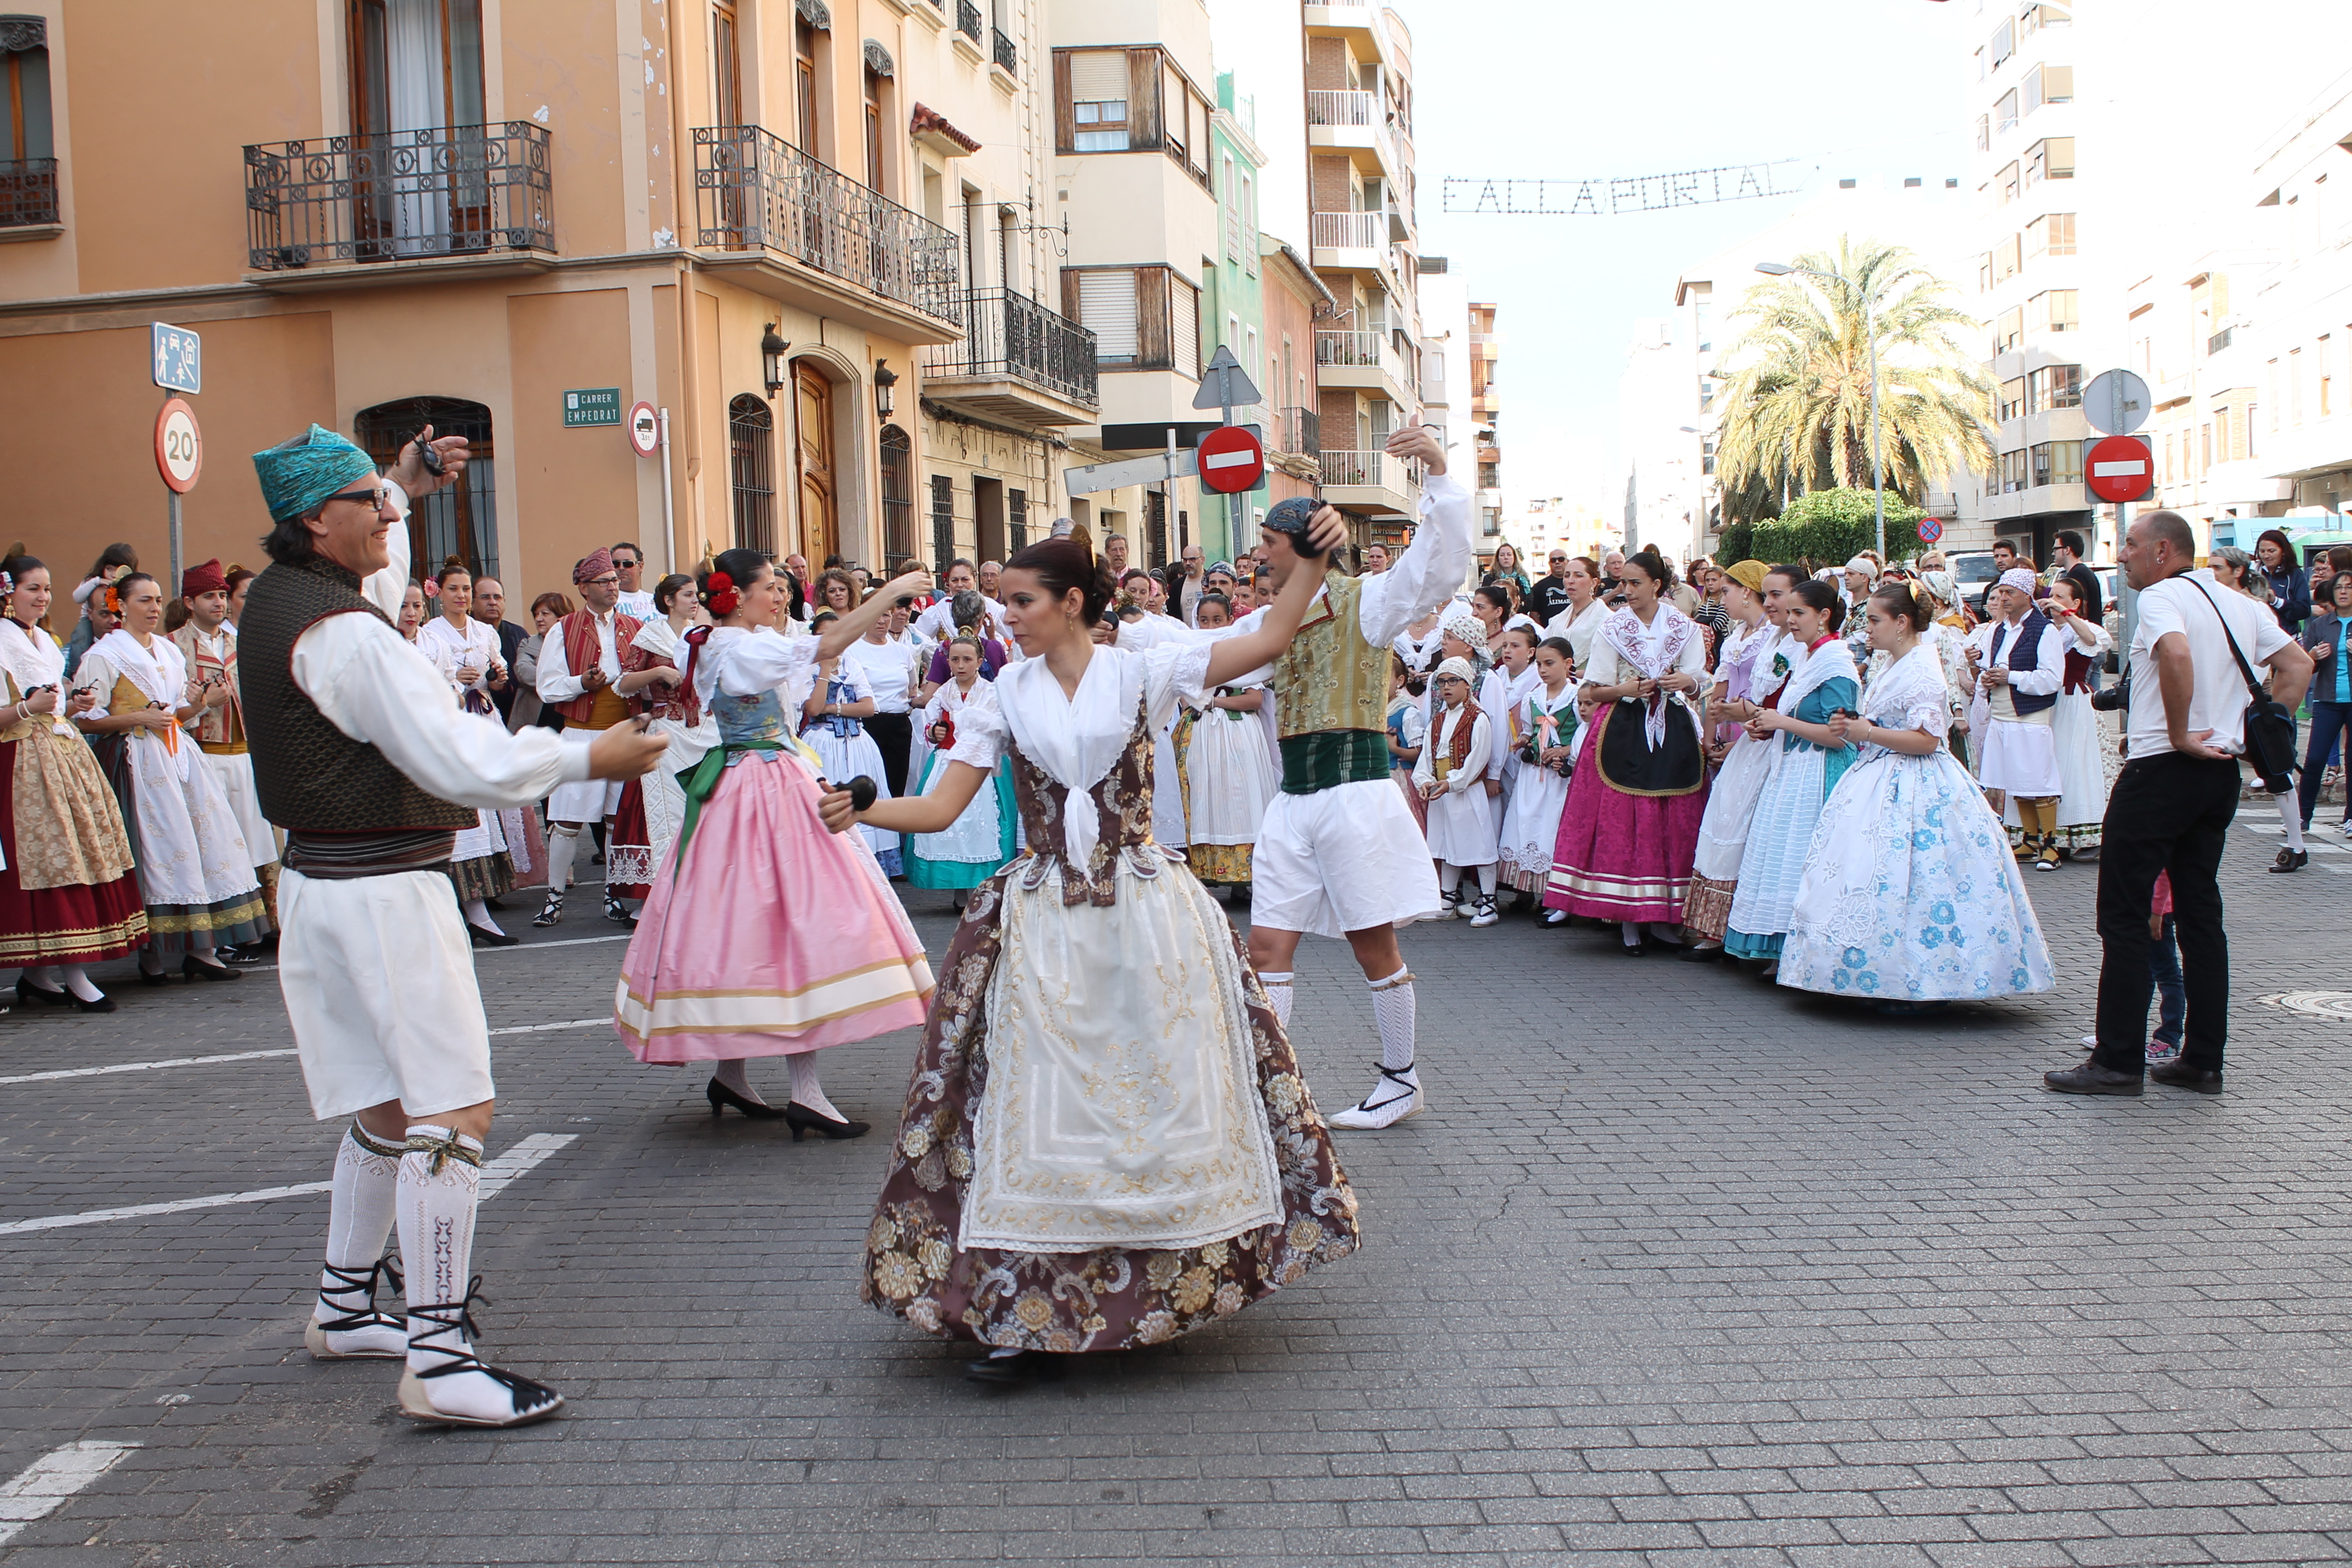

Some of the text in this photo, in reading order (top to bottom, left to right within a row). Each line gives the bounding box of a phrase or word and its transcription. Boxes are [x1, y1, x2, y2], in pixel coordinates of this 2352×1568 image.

[1443, 178, 1597, 214] FALLA
[581, 394, 612, 404] CARRER
[568, 409, 617, 422] EMPEDRAT
[168, 429, 193, 462] 20
[1547, 596, 1572, 606] ALIMAR
